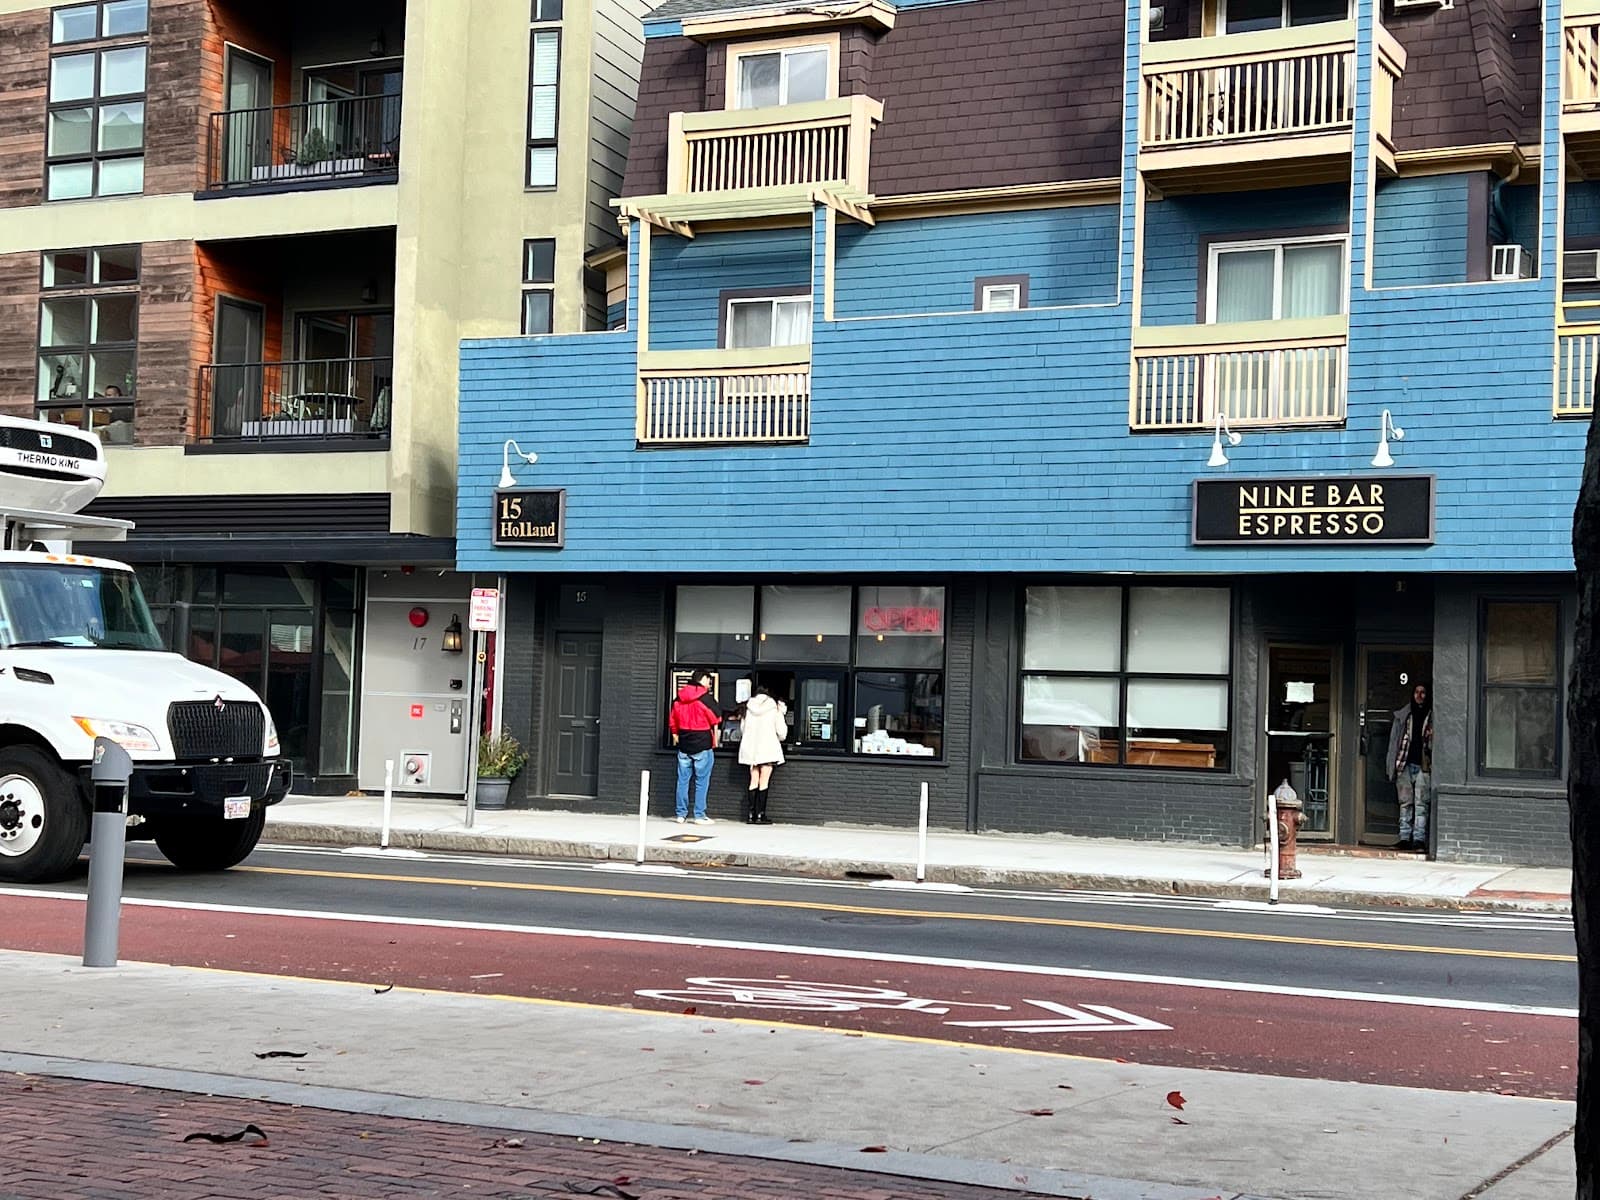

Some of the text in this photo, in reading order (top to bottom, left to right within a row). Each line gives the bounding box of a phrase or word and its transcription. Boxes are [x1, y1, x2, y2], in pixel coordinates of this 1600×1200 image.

[17, 452, 80, 470] THERMO KING
[1239, 483, 1385, 507] NINE BAR
[500, 497, 522, 520] 15
[500, 521, 556, 538] Holland
[1239, 513, 1384, 535] ESPRESSO
[864, 607, 940, 632] OPEN
[413, 637, 428, 650] 17
[1400, 672, 1409, 685] 9
